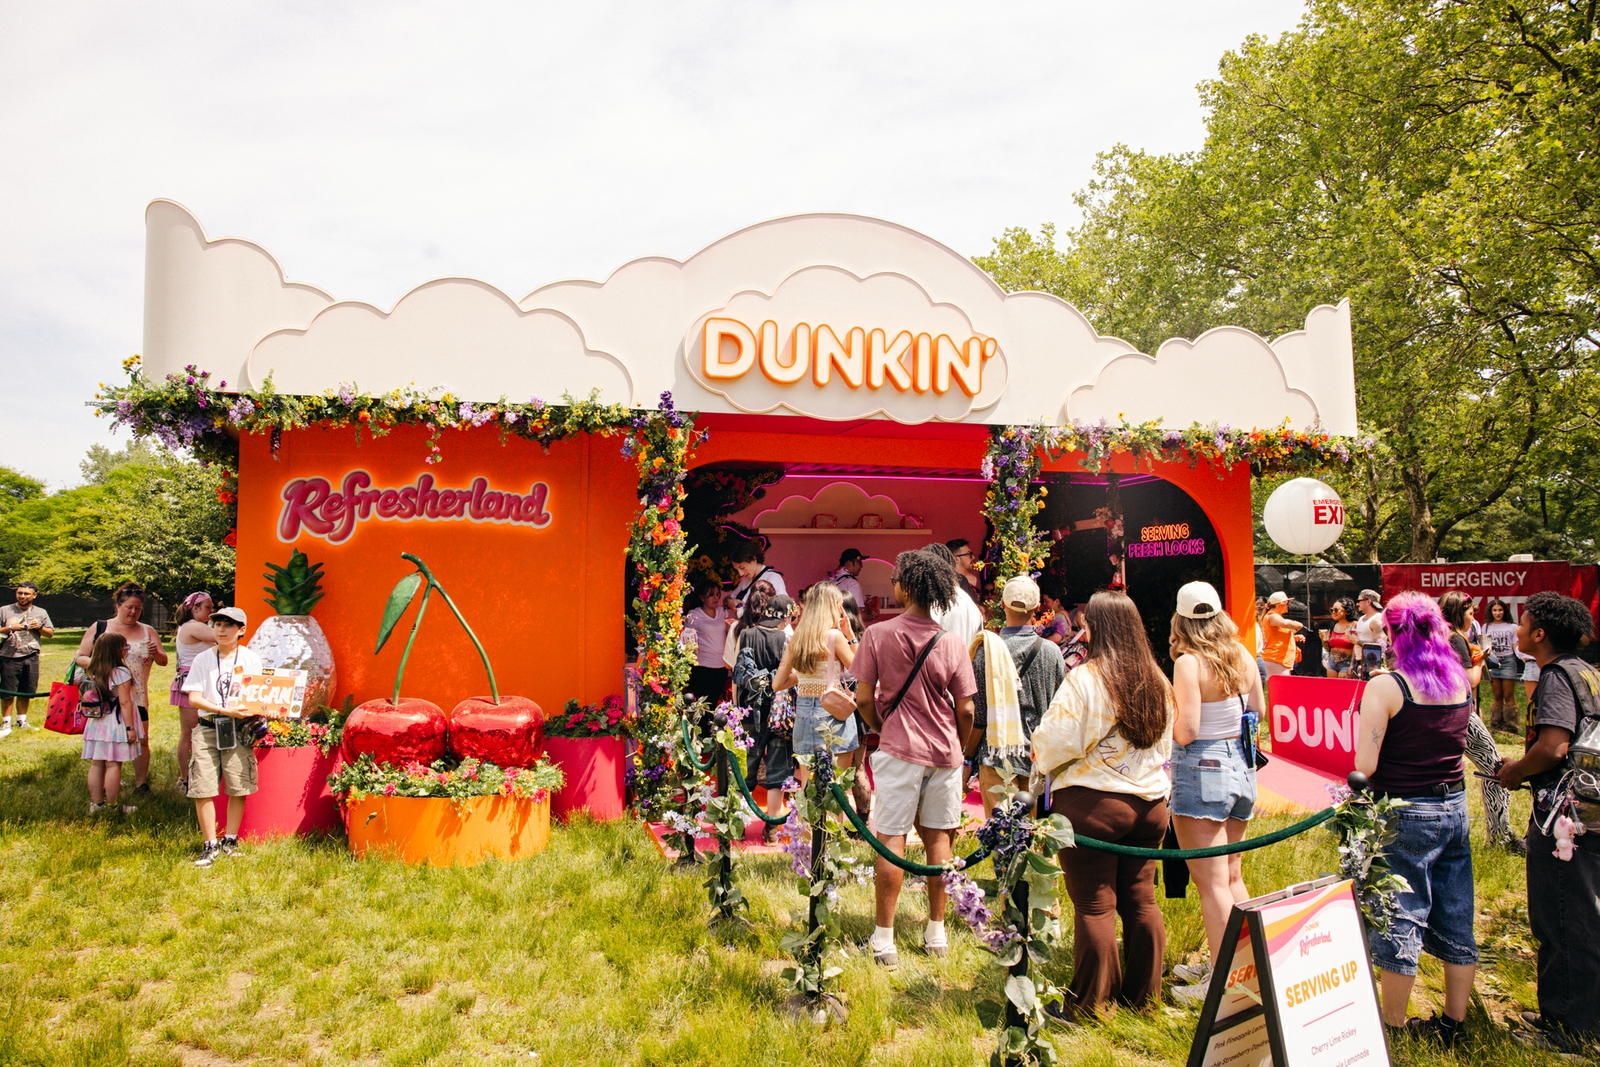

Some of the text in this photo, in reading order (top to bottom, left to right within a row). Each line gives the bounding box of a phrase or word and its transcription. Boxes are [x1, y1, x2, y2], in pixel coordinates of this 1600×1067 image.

[702, 317, 997, 396] DUNKIN'
[278, 469, 552, 544] Refresherland
[1141, 523, 1190, 542] SERVING
[1128, 538, 1205, 558] FRESH LOOKS
[1421, 571, 1527, 587] EMERGENCY
[239, 684, 294, 705] MEGAN
[1285, 960, 1358, 1009] SERVING UP
[1213, 1023, 1267, 1051] Pink Pineapple Lemo
[1311, 1027, 1357, 1056] Cherry Lime Rickey
[1343, 1048, 1369, 1067] Lemonade
